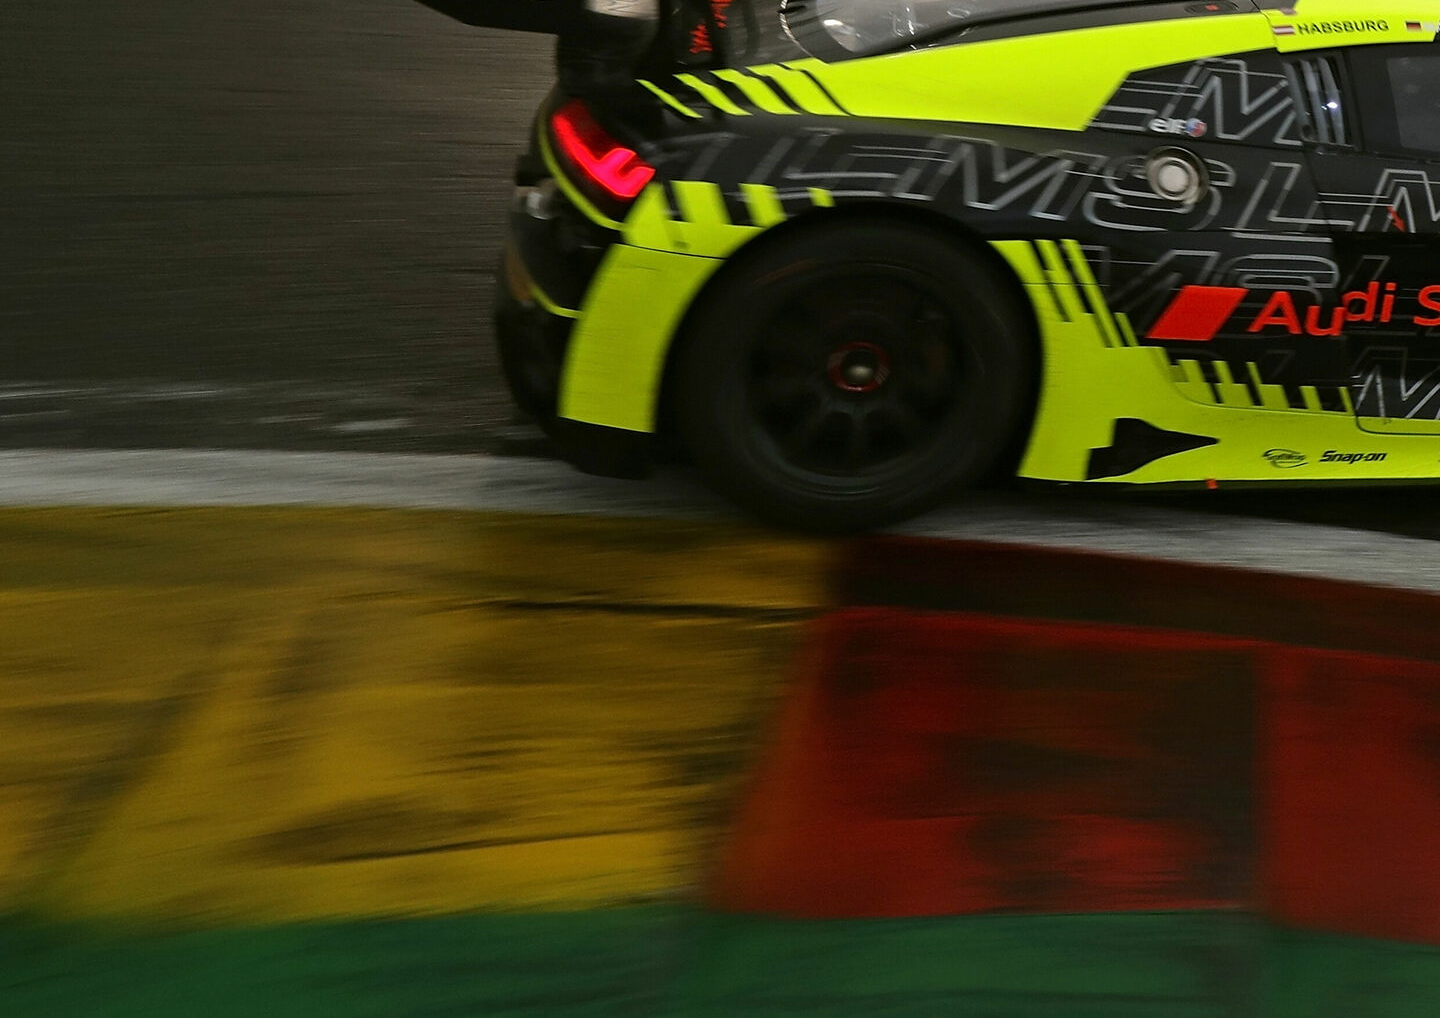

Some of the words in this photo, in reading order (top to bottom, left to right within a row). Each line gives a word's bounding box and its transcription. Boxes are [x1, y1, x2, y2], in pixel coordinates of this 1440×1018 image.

[1297, 20, 1389, 36] HABSBURG
[1246, 281, 1396, 337] Audi
[1318, 449, 1388, 464] Snap-on
